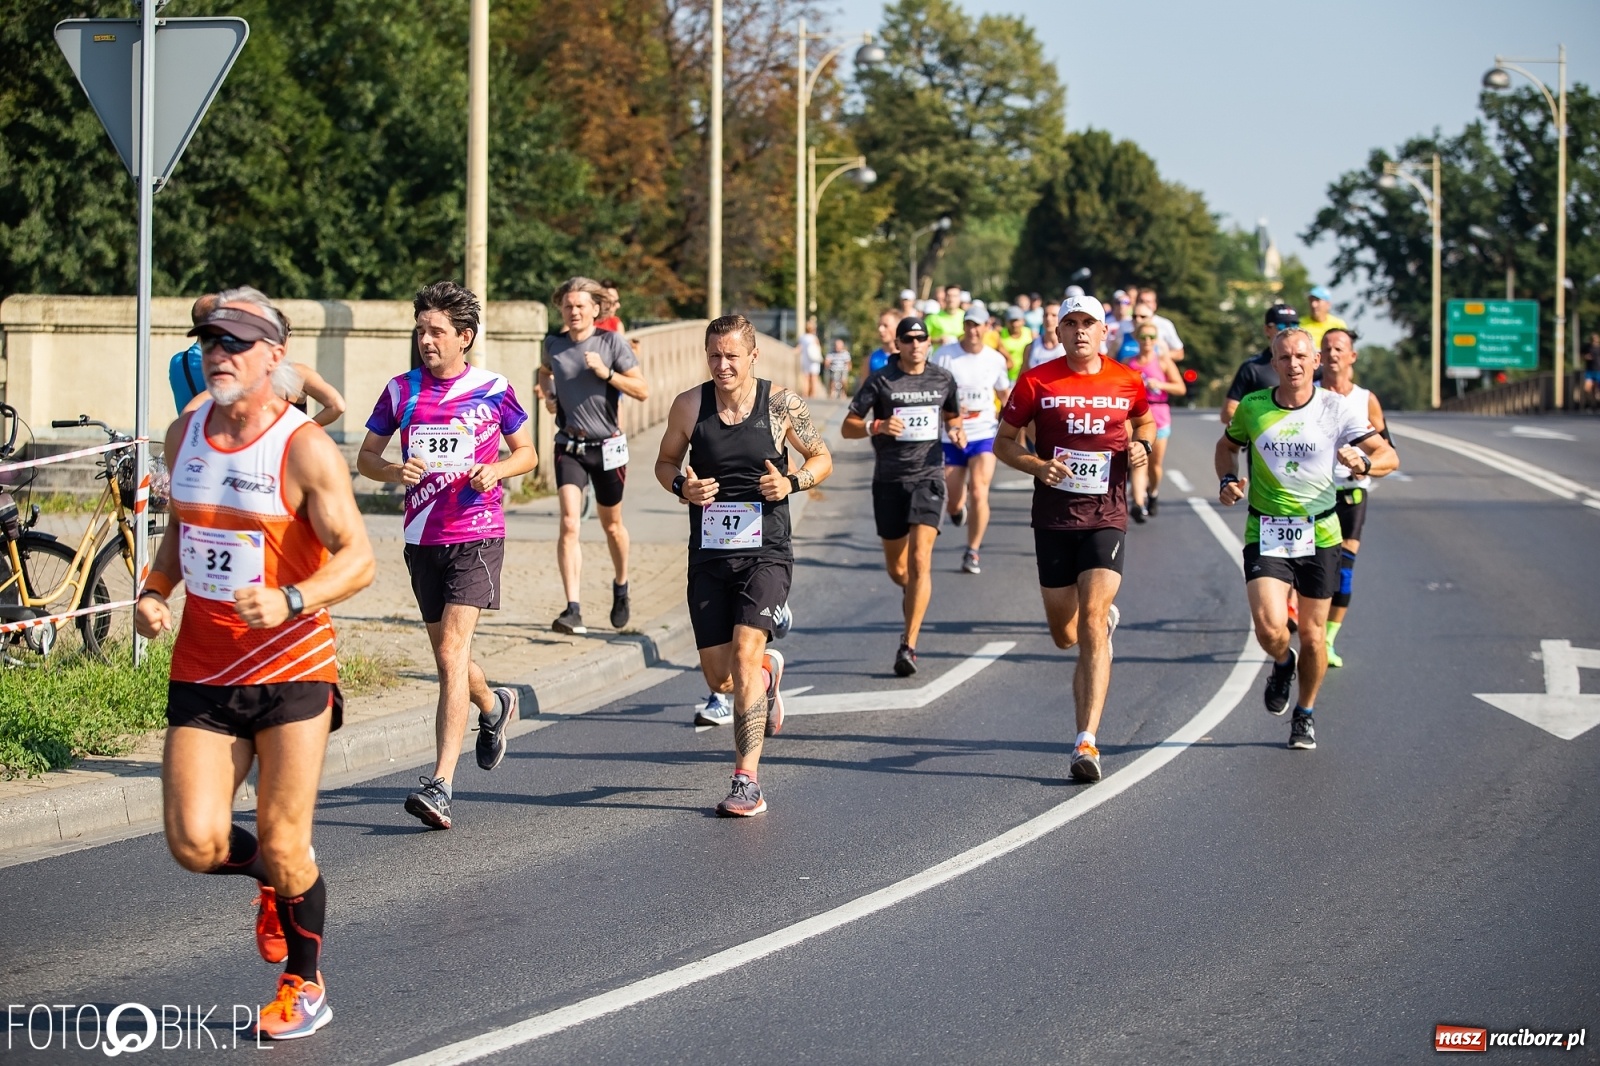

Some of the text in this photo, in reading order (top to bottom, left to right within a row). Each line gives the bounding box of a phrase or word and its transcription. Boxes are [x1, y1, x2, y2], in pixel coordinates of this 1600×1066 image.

[891, 390, 942, 400] PITBULL
[909, 416, 929, 427] 225
[429, 438, 458, 453] 387
[1263, 442, 1316, 452] AKTYWNI
[1070, 463, 1097, 477] 284
[722, 515, 741, 530] 47
[1277, 528, 1302, 541] 300
[207, 548, 232, 572] 32
